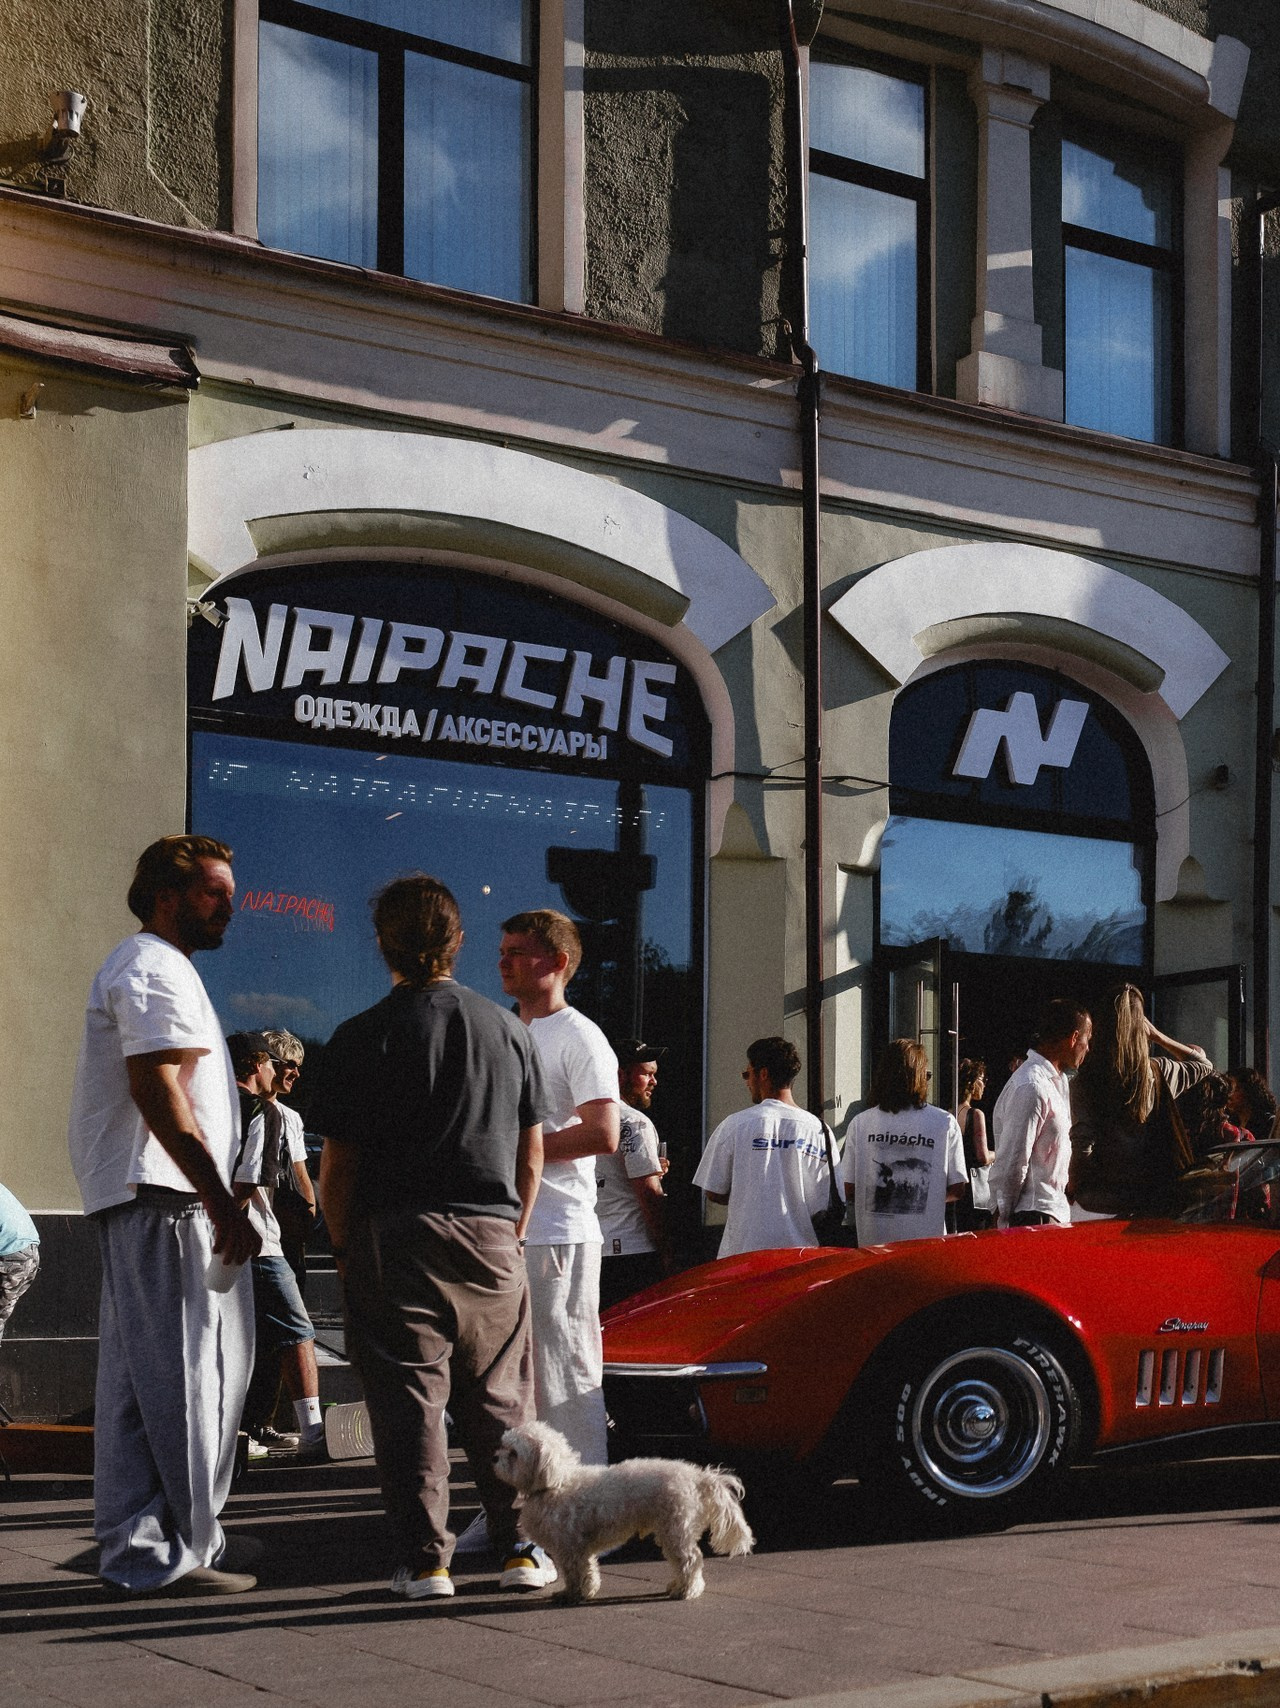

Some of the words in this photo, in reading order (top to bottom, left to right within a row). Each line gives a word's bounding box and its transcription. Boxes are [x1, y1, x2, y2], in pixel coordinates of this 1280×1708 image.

[212, 596, 677, 758] NAIPACHE
[295, 694, 421, 738] ОДЕЖДА
[438, 714, 608, 760] АКСЕССУАРЫ
[1160, 1317, 1210, 1332] Stingray
[1012, 1336, 1067, 1468] FIREHAWK
